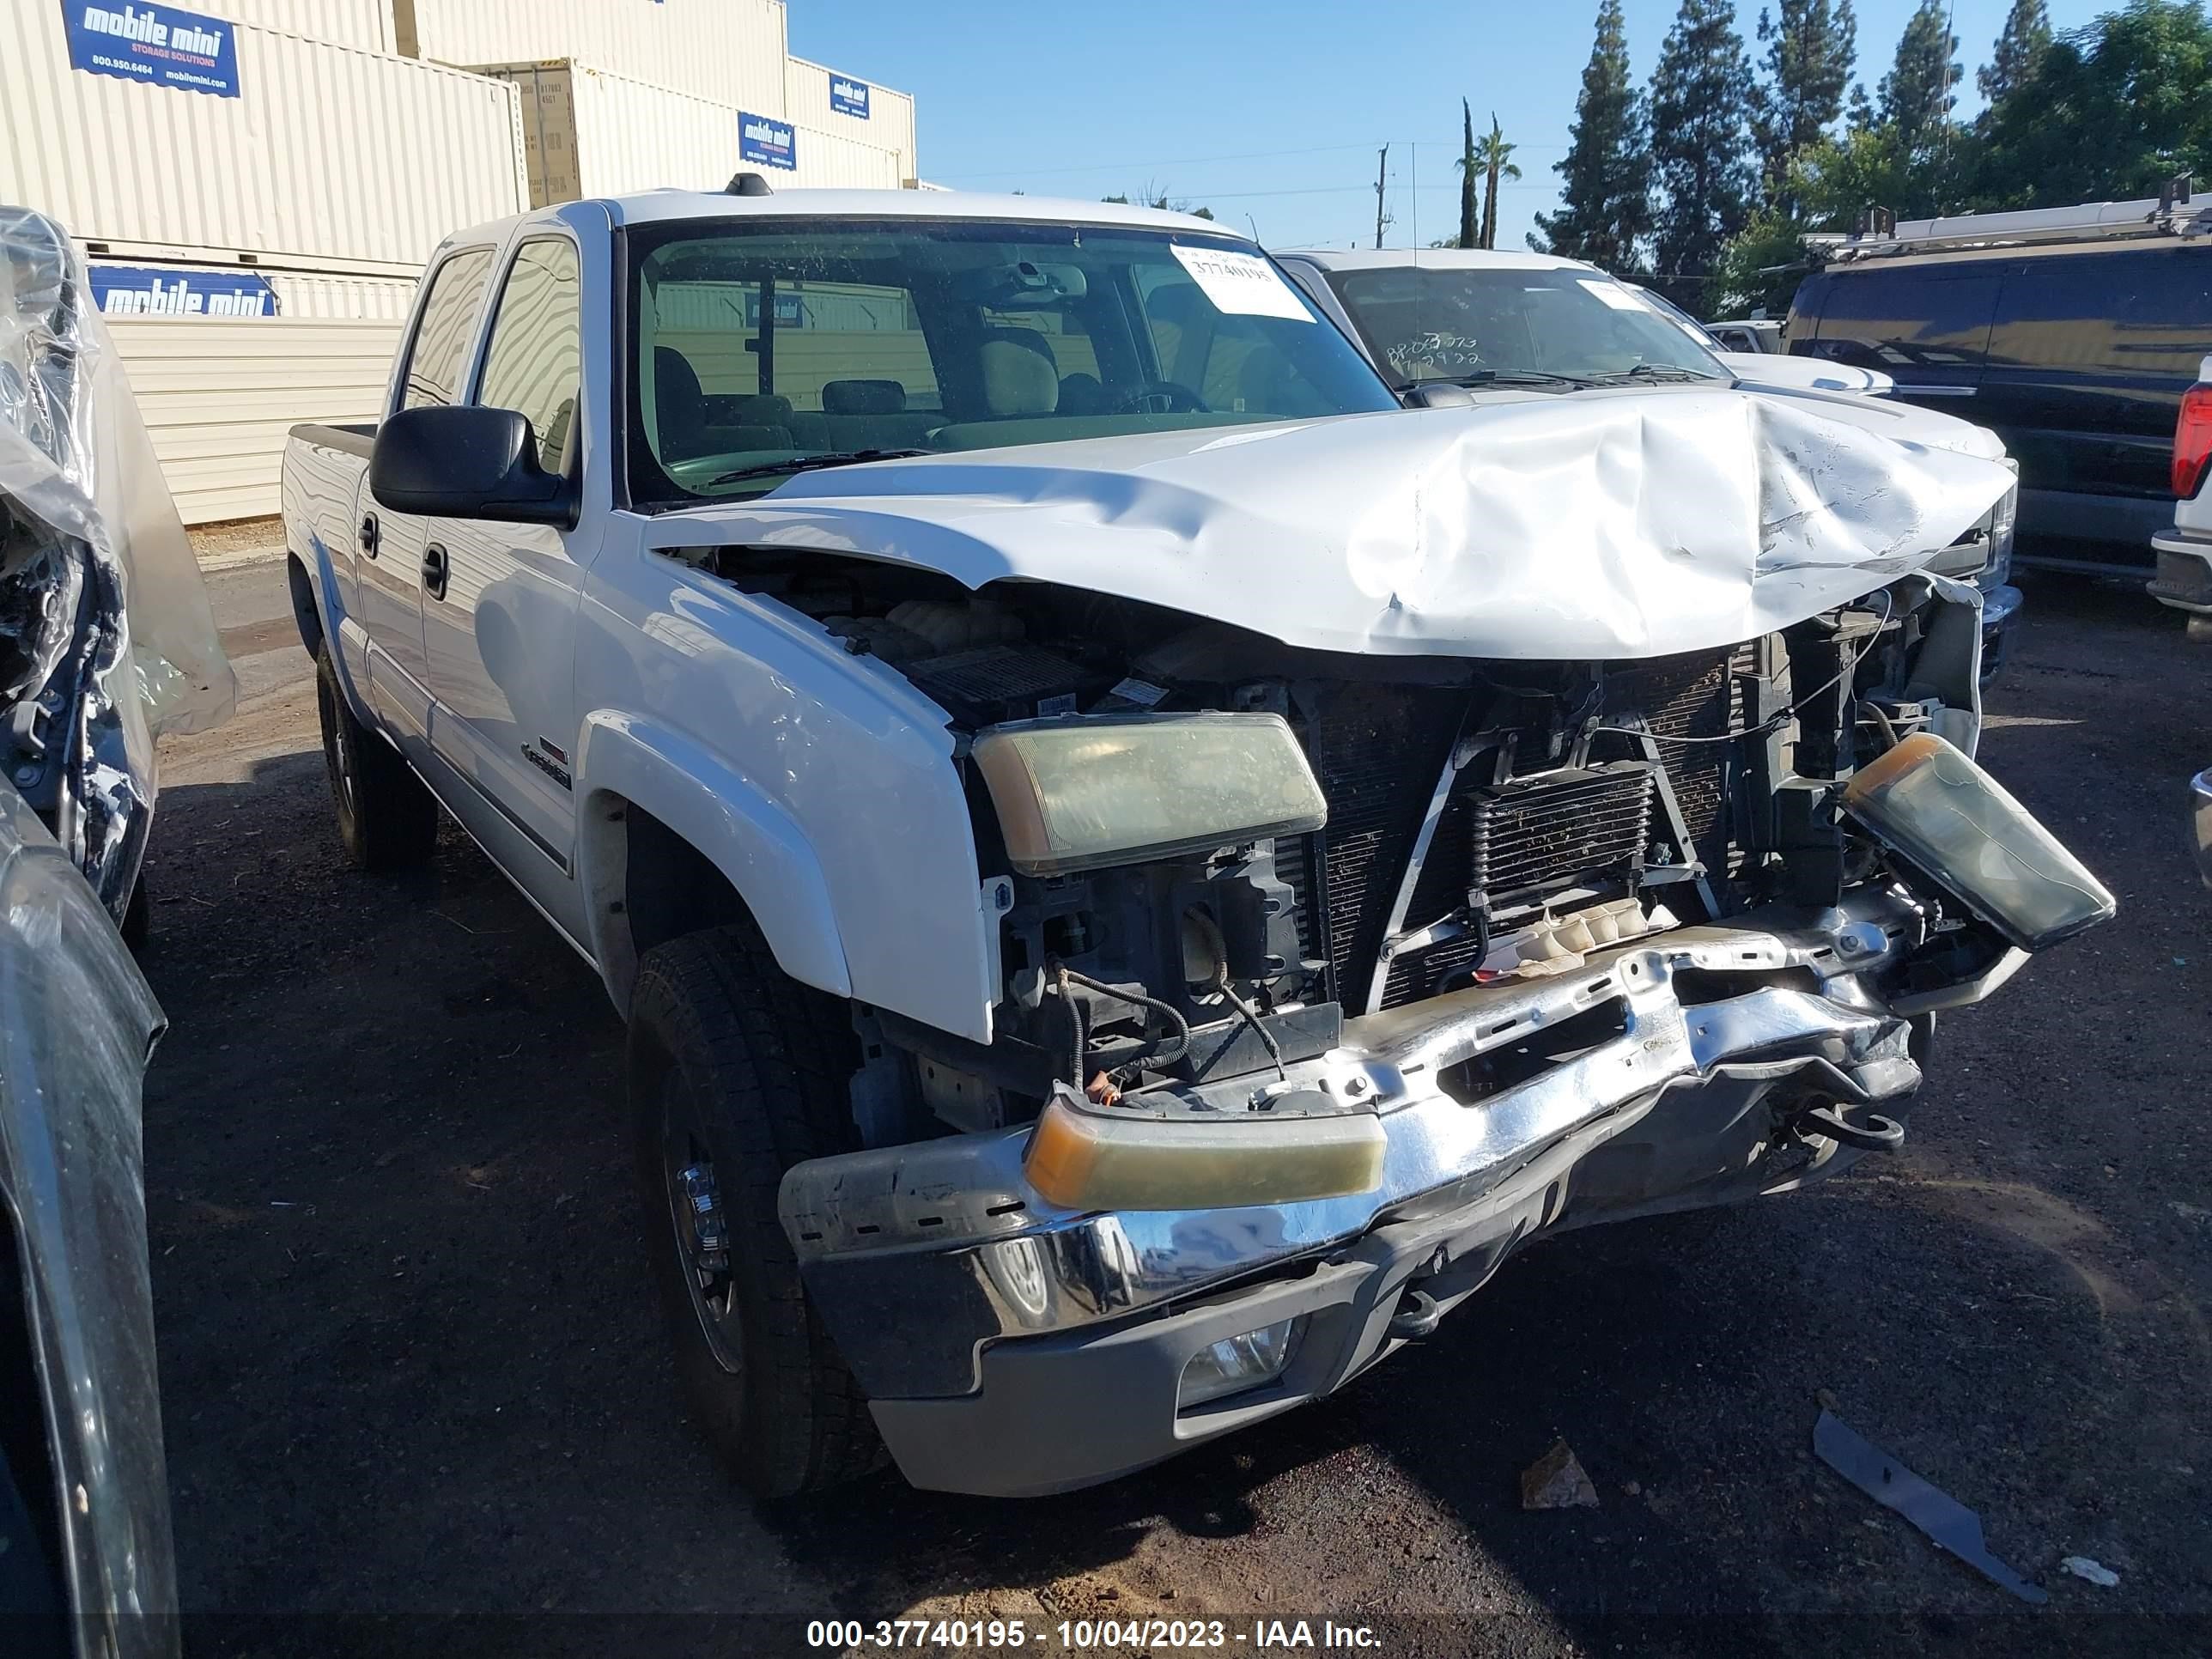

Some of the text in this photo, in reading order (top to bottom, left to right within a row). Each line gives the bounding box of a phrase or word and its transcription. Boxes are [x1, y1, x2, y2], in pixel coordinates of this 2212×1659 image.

[84, 6, 222, 58] mobile mini
[92, 54, 153, 76] 800.950.6464
[131, 43, 216, 68] STORAGE SOLUTIONS
[166, 70, 228, 89] mobilemini.com
[744, 120, 773, 144] mobile
[774, 129, 792, 149] mini
[1192, 261, 1272, 282] 37740195
[105, 278, 266, 317] mobile mini
